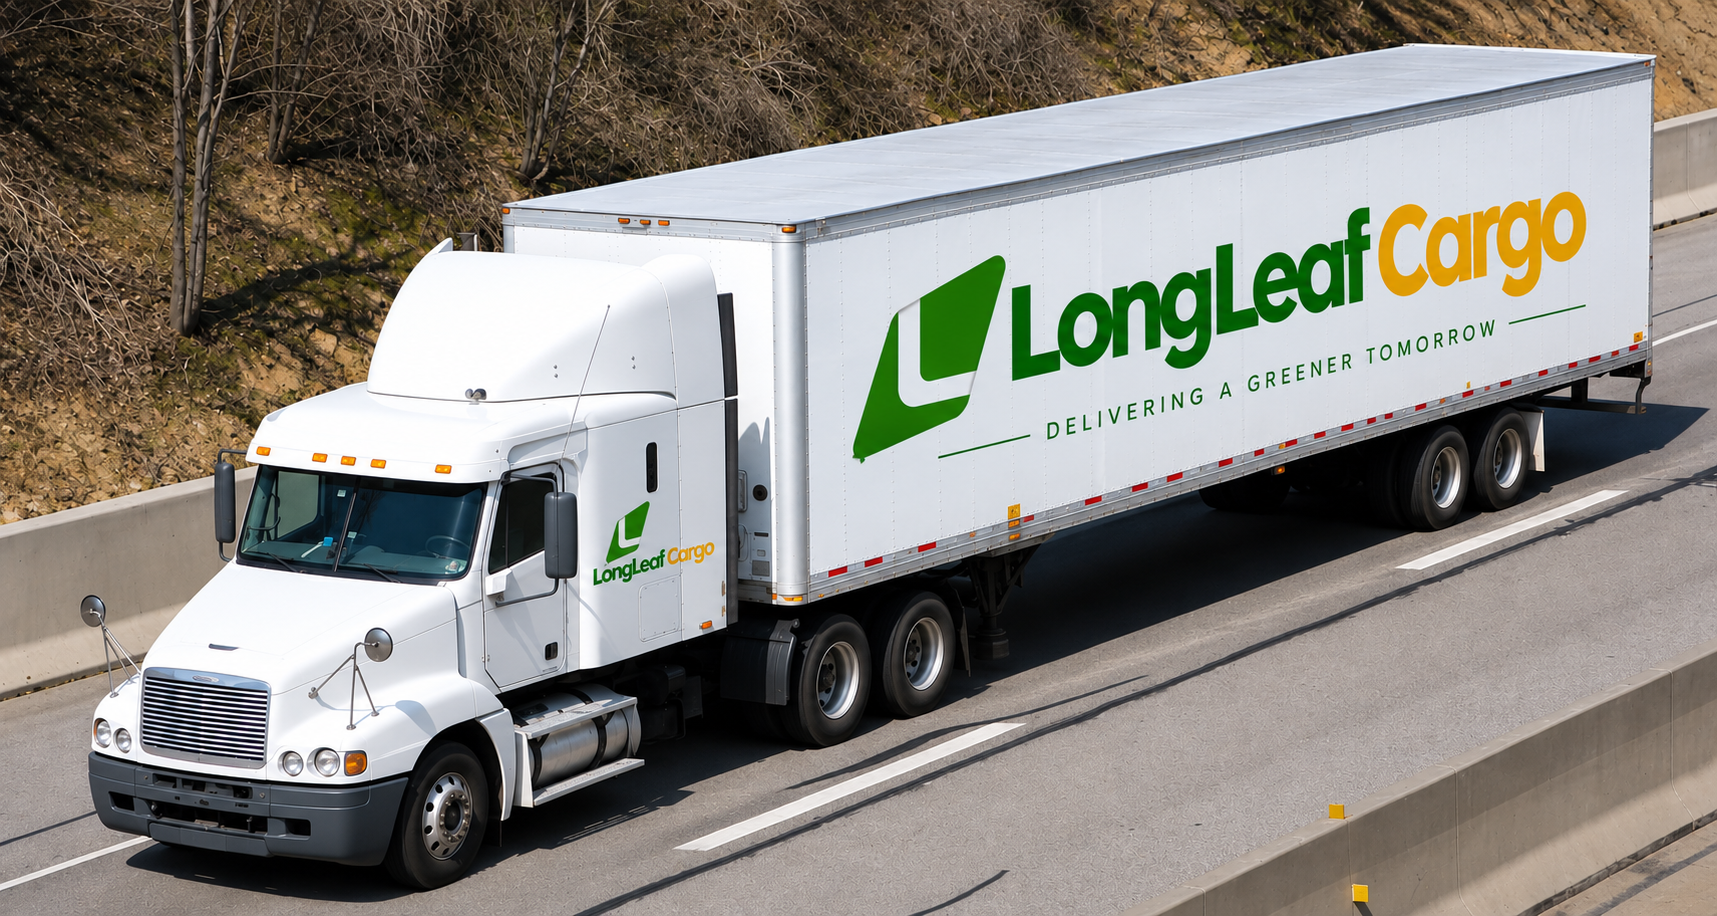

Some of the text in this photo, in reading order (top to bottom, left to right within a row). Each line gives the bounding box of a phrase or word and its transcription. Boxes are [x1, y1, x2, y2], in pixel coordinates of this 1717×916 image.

[1012, 192, 1586, 381] LongLeaf Cargo
[1046, 319, 1495, 440] DELIVERING A GREENER TOMORROW
[593, 542, 715, 586] LongLeaf Cargo
